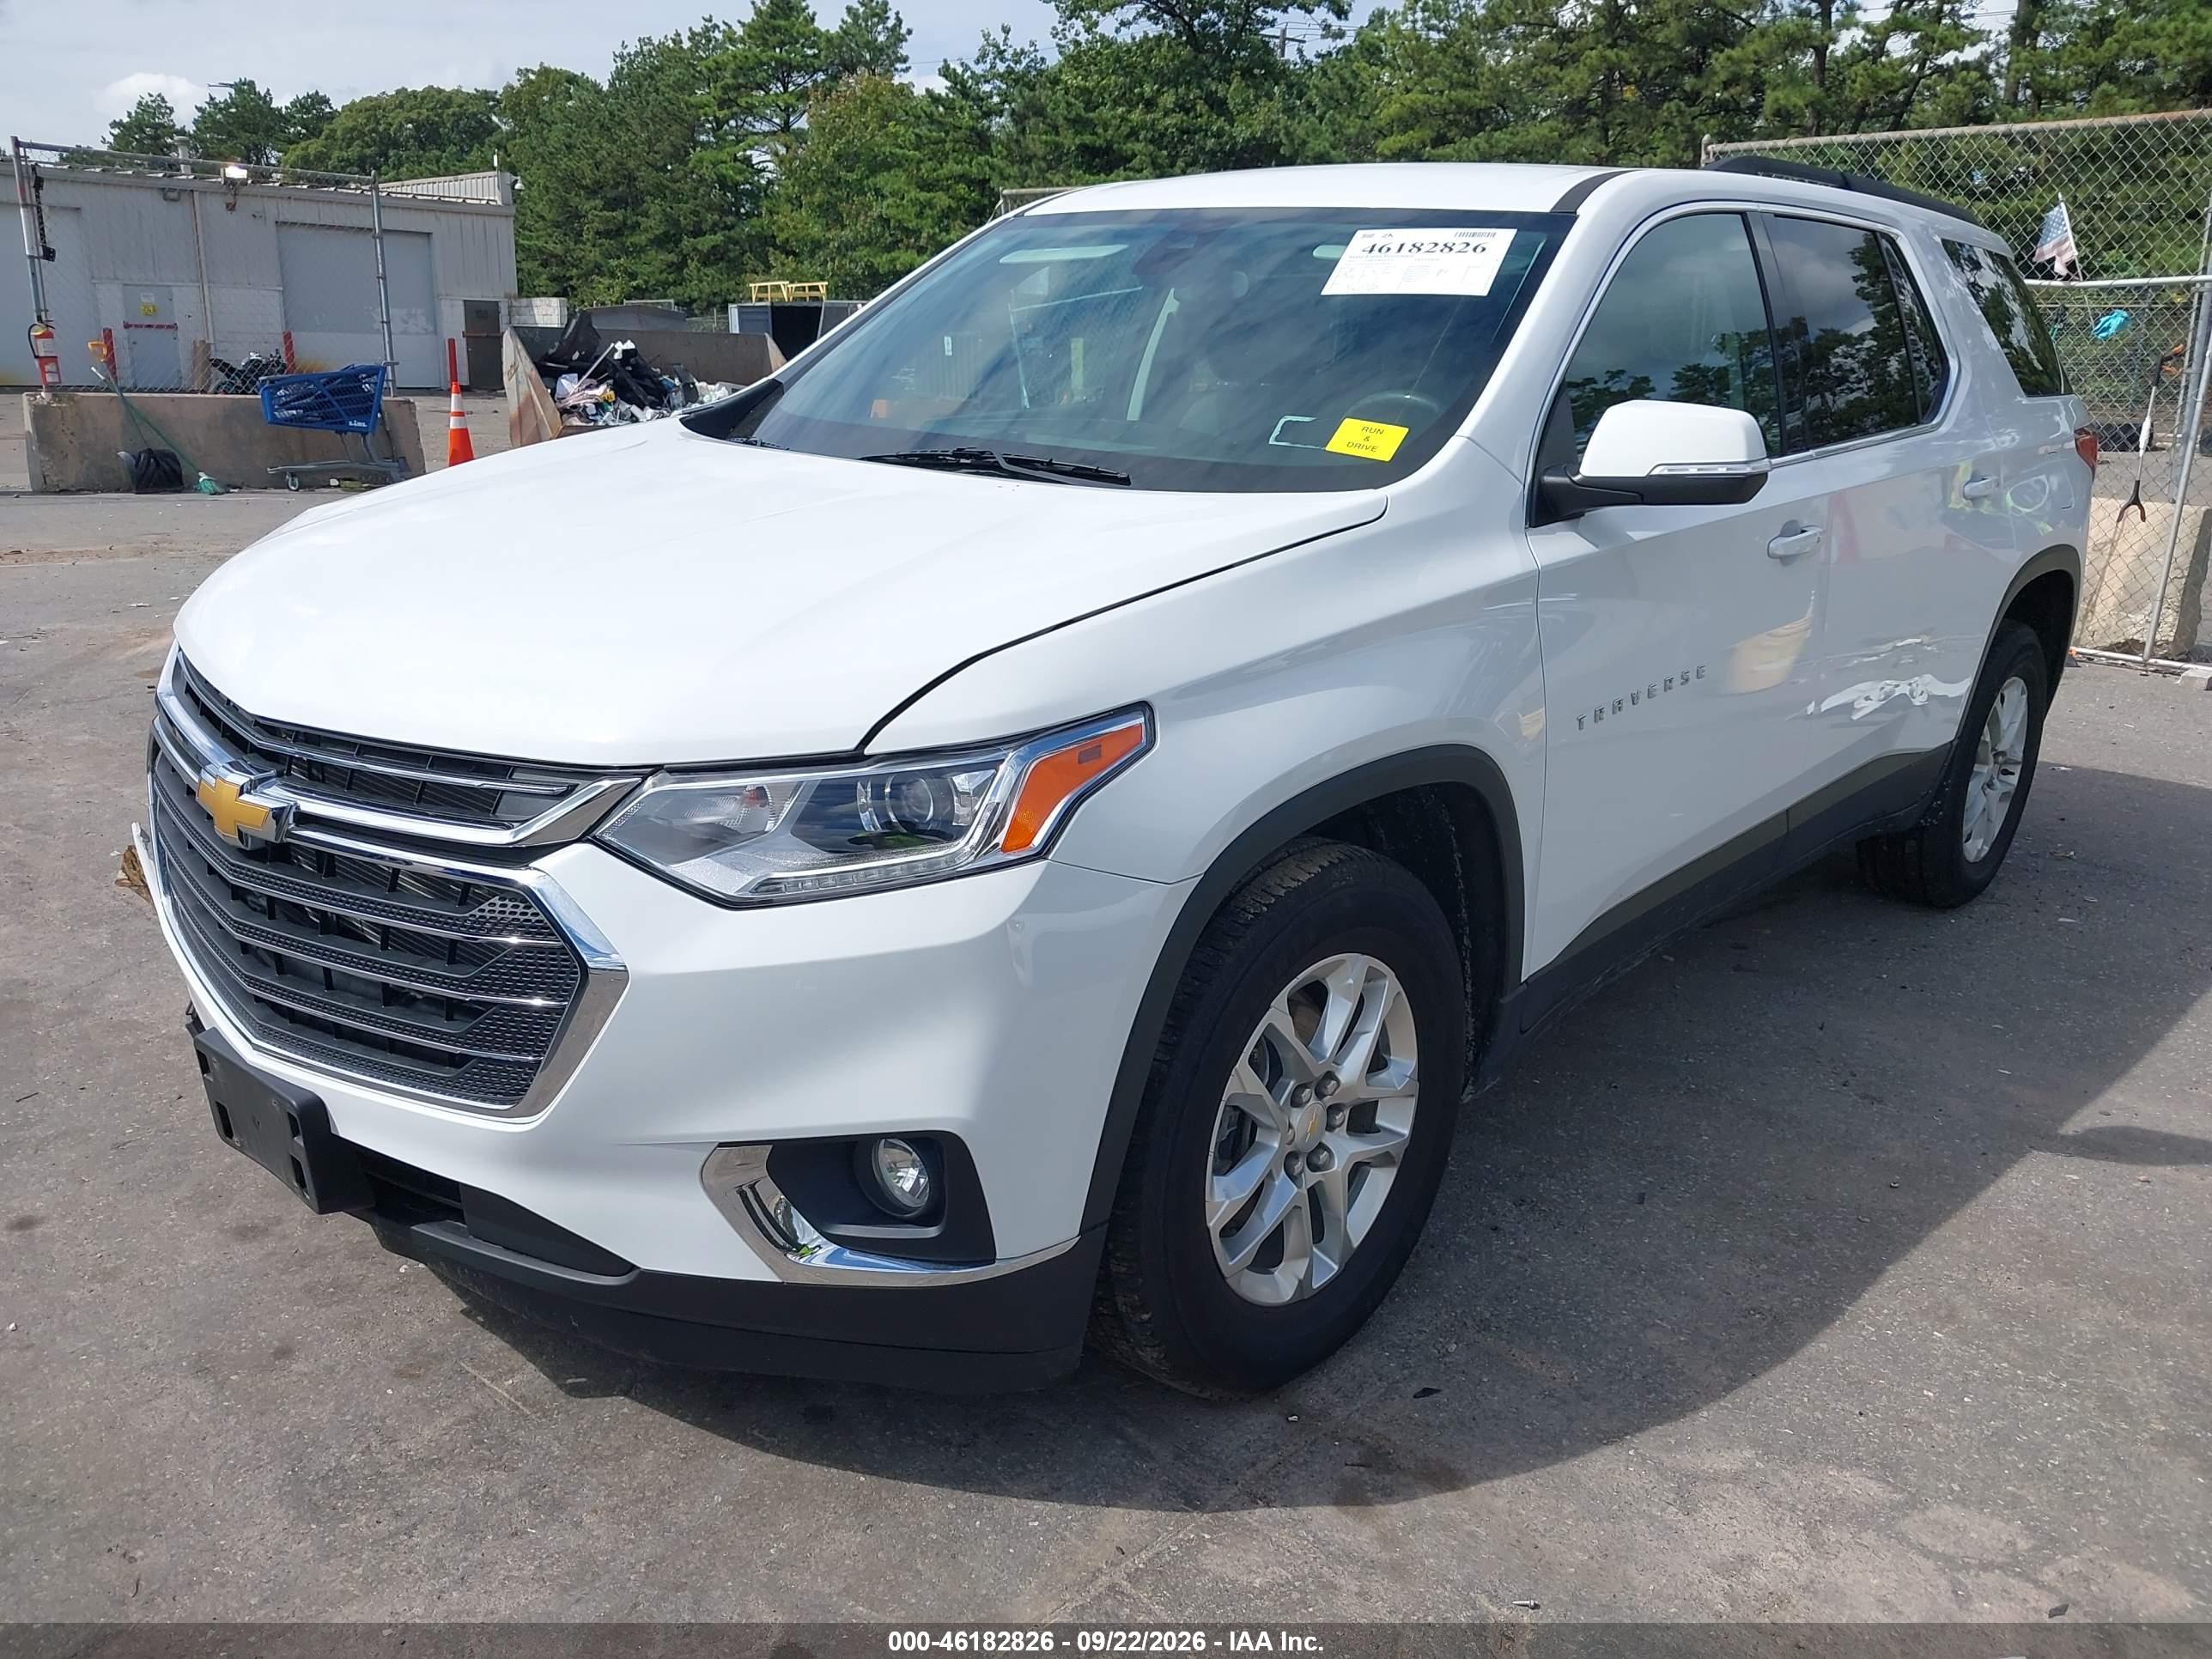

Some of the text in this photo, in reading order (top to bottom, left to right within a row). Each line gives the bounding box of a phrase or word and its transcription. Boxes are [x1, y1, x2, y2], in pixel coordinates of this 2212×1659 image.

[1361, 241, 1487, 254] 46182826
[1361, 426, 1385, 435] RUN
[1346, 441, 1379, 453] DRIVE
[1577, 665, 1707, 730] TRAVERSE
